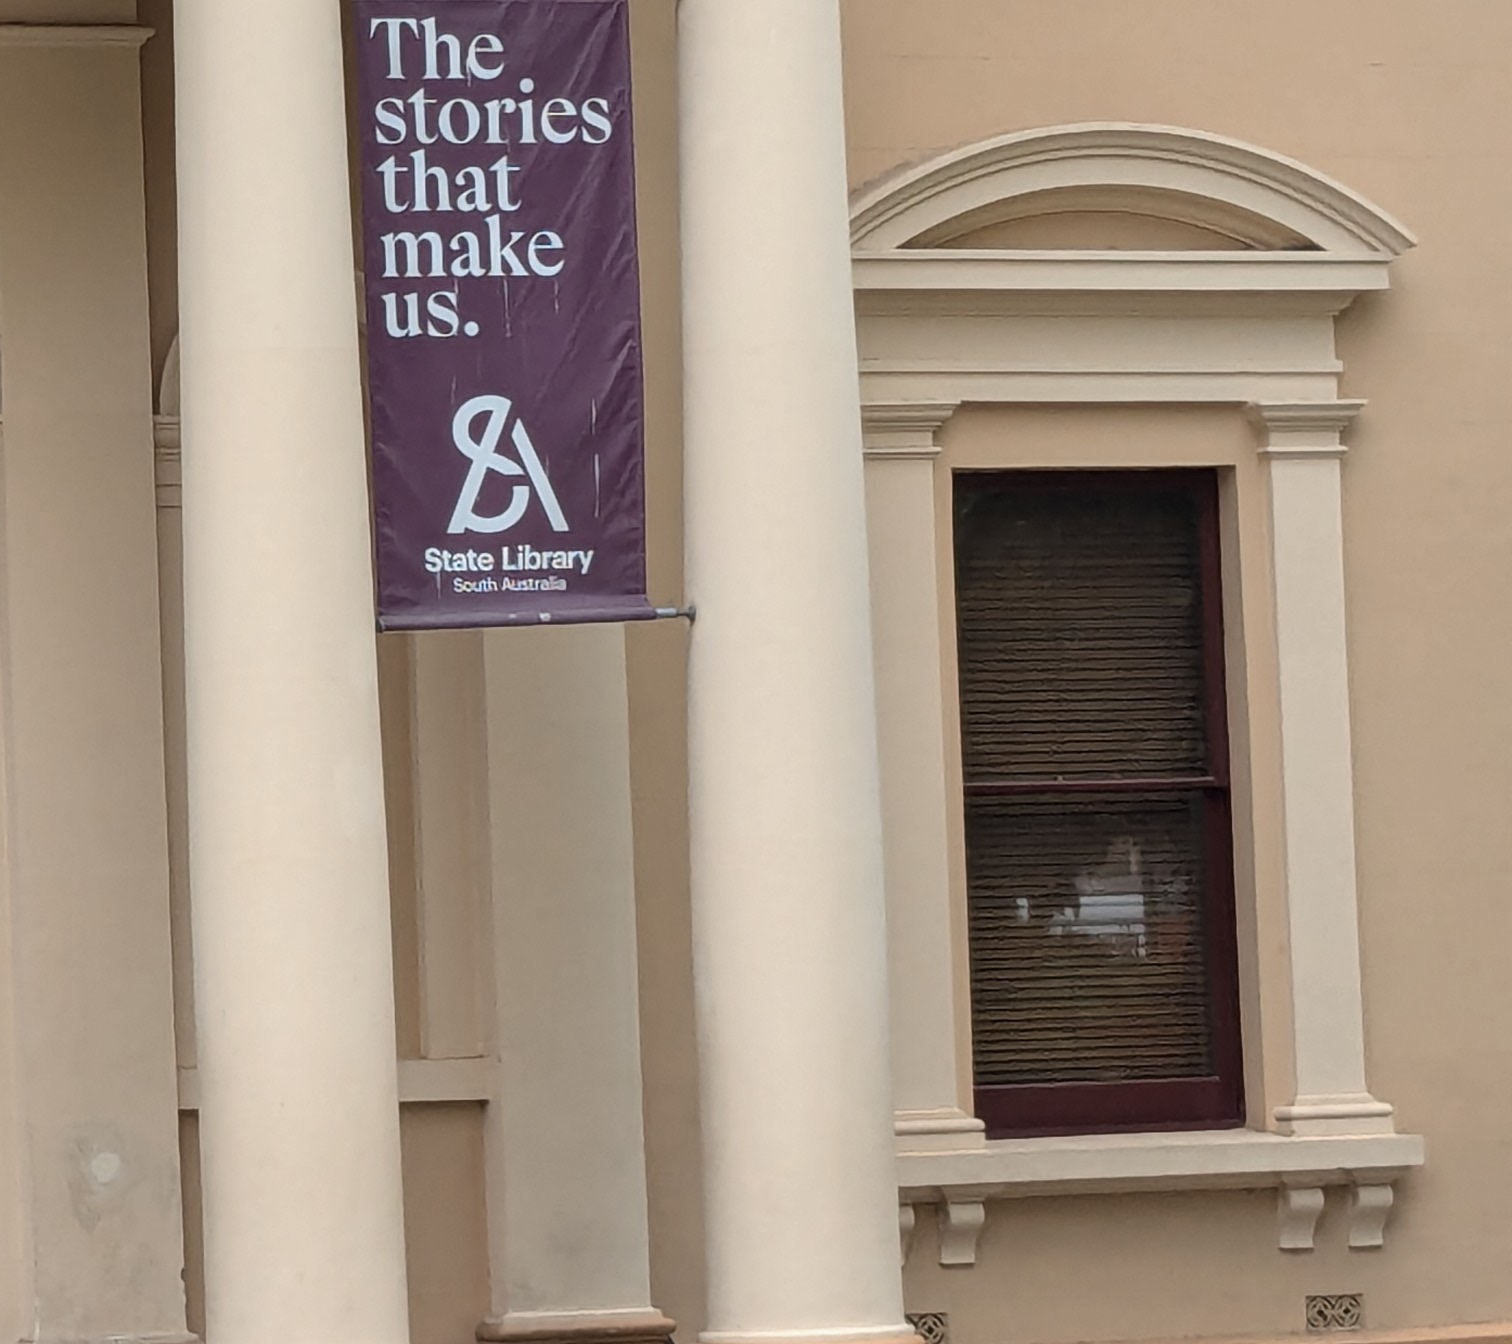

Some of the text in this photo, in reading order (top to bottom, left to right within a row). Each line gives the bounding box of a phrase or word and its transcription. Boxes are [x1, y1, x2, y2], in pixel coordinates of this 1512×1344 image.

[369, 16, 505, 80] The
[375, 77, 612, 144] stories
[376, 148, 522, 212] that
[380, 213, 565, 277] make
[382, 291, 480, 338] us.
[424, 544, 594, 575] State Library
[453, 575, 567, 593] South Australia
